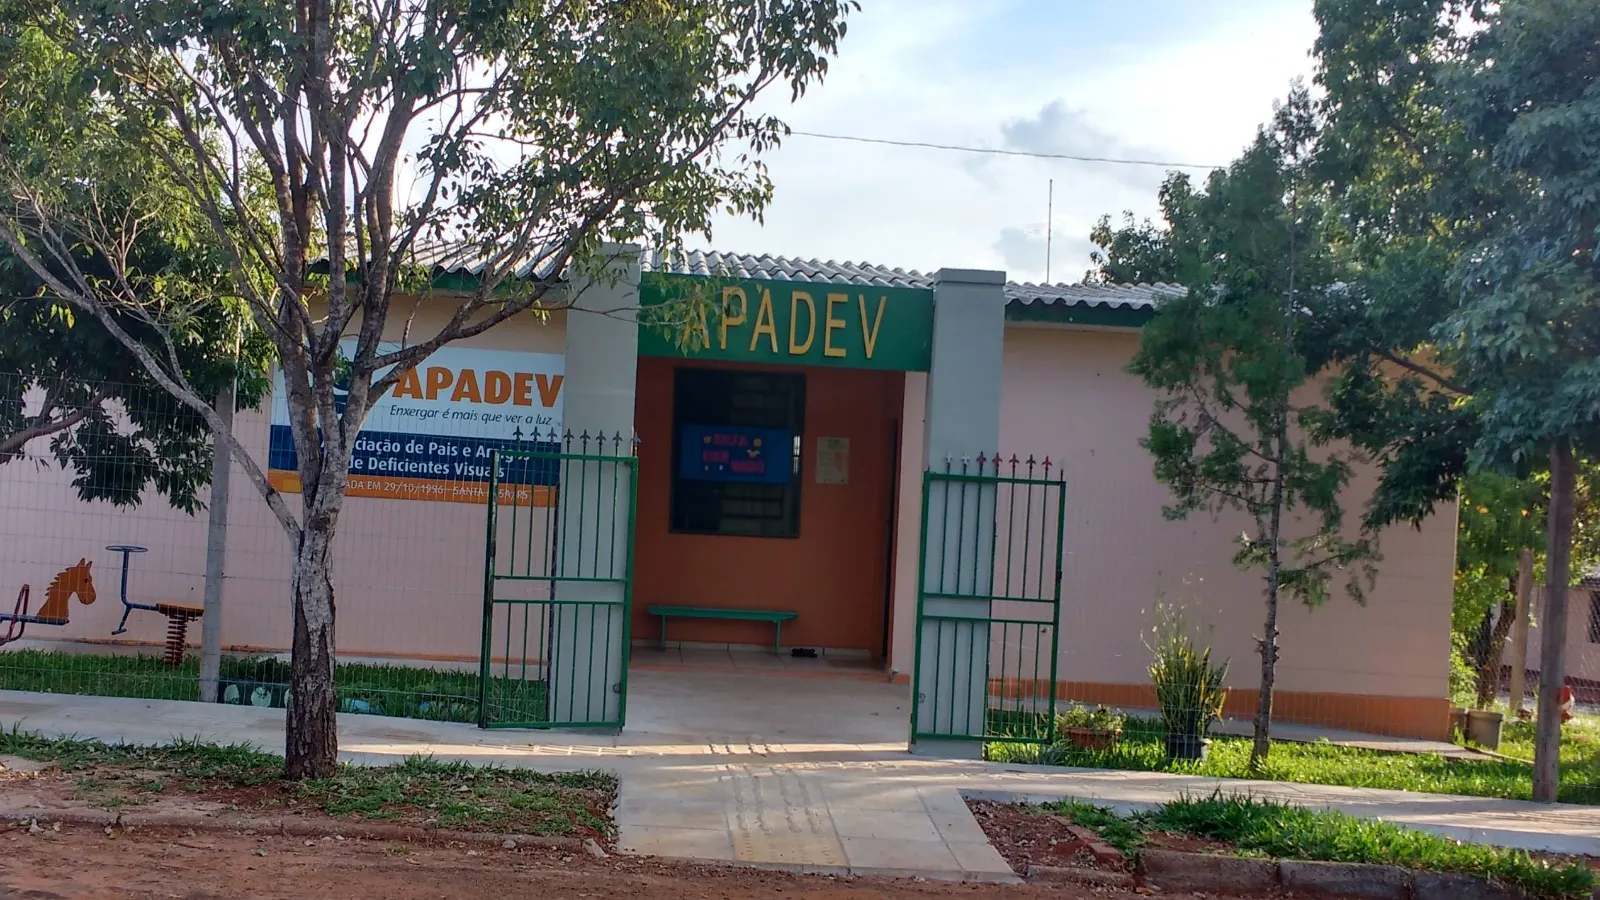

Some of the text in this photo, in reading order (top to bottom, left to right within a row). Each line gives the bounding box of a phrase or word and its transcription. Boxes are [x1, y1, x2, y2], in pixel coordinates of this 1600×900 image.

[683, 284, 887, 359] APADEV
[391, 366, 565, 408] APADEV
[389, 405, 552, 425] Enxergar é mais que ver a luz
[321, 436, 400, 454] ciação
[405, 439, 424, 454] de
[428, 441, 458, 456] Pais
[462, 446, 471, 457] e
[368, 457, 450, 475] Deficientes
[454, 461, 505, 477] Visuas
[367, 481, 381, 490] EM
[384, 481, 444, 494] 29/10/1996
[453, 486, 484, 497] SANTA
